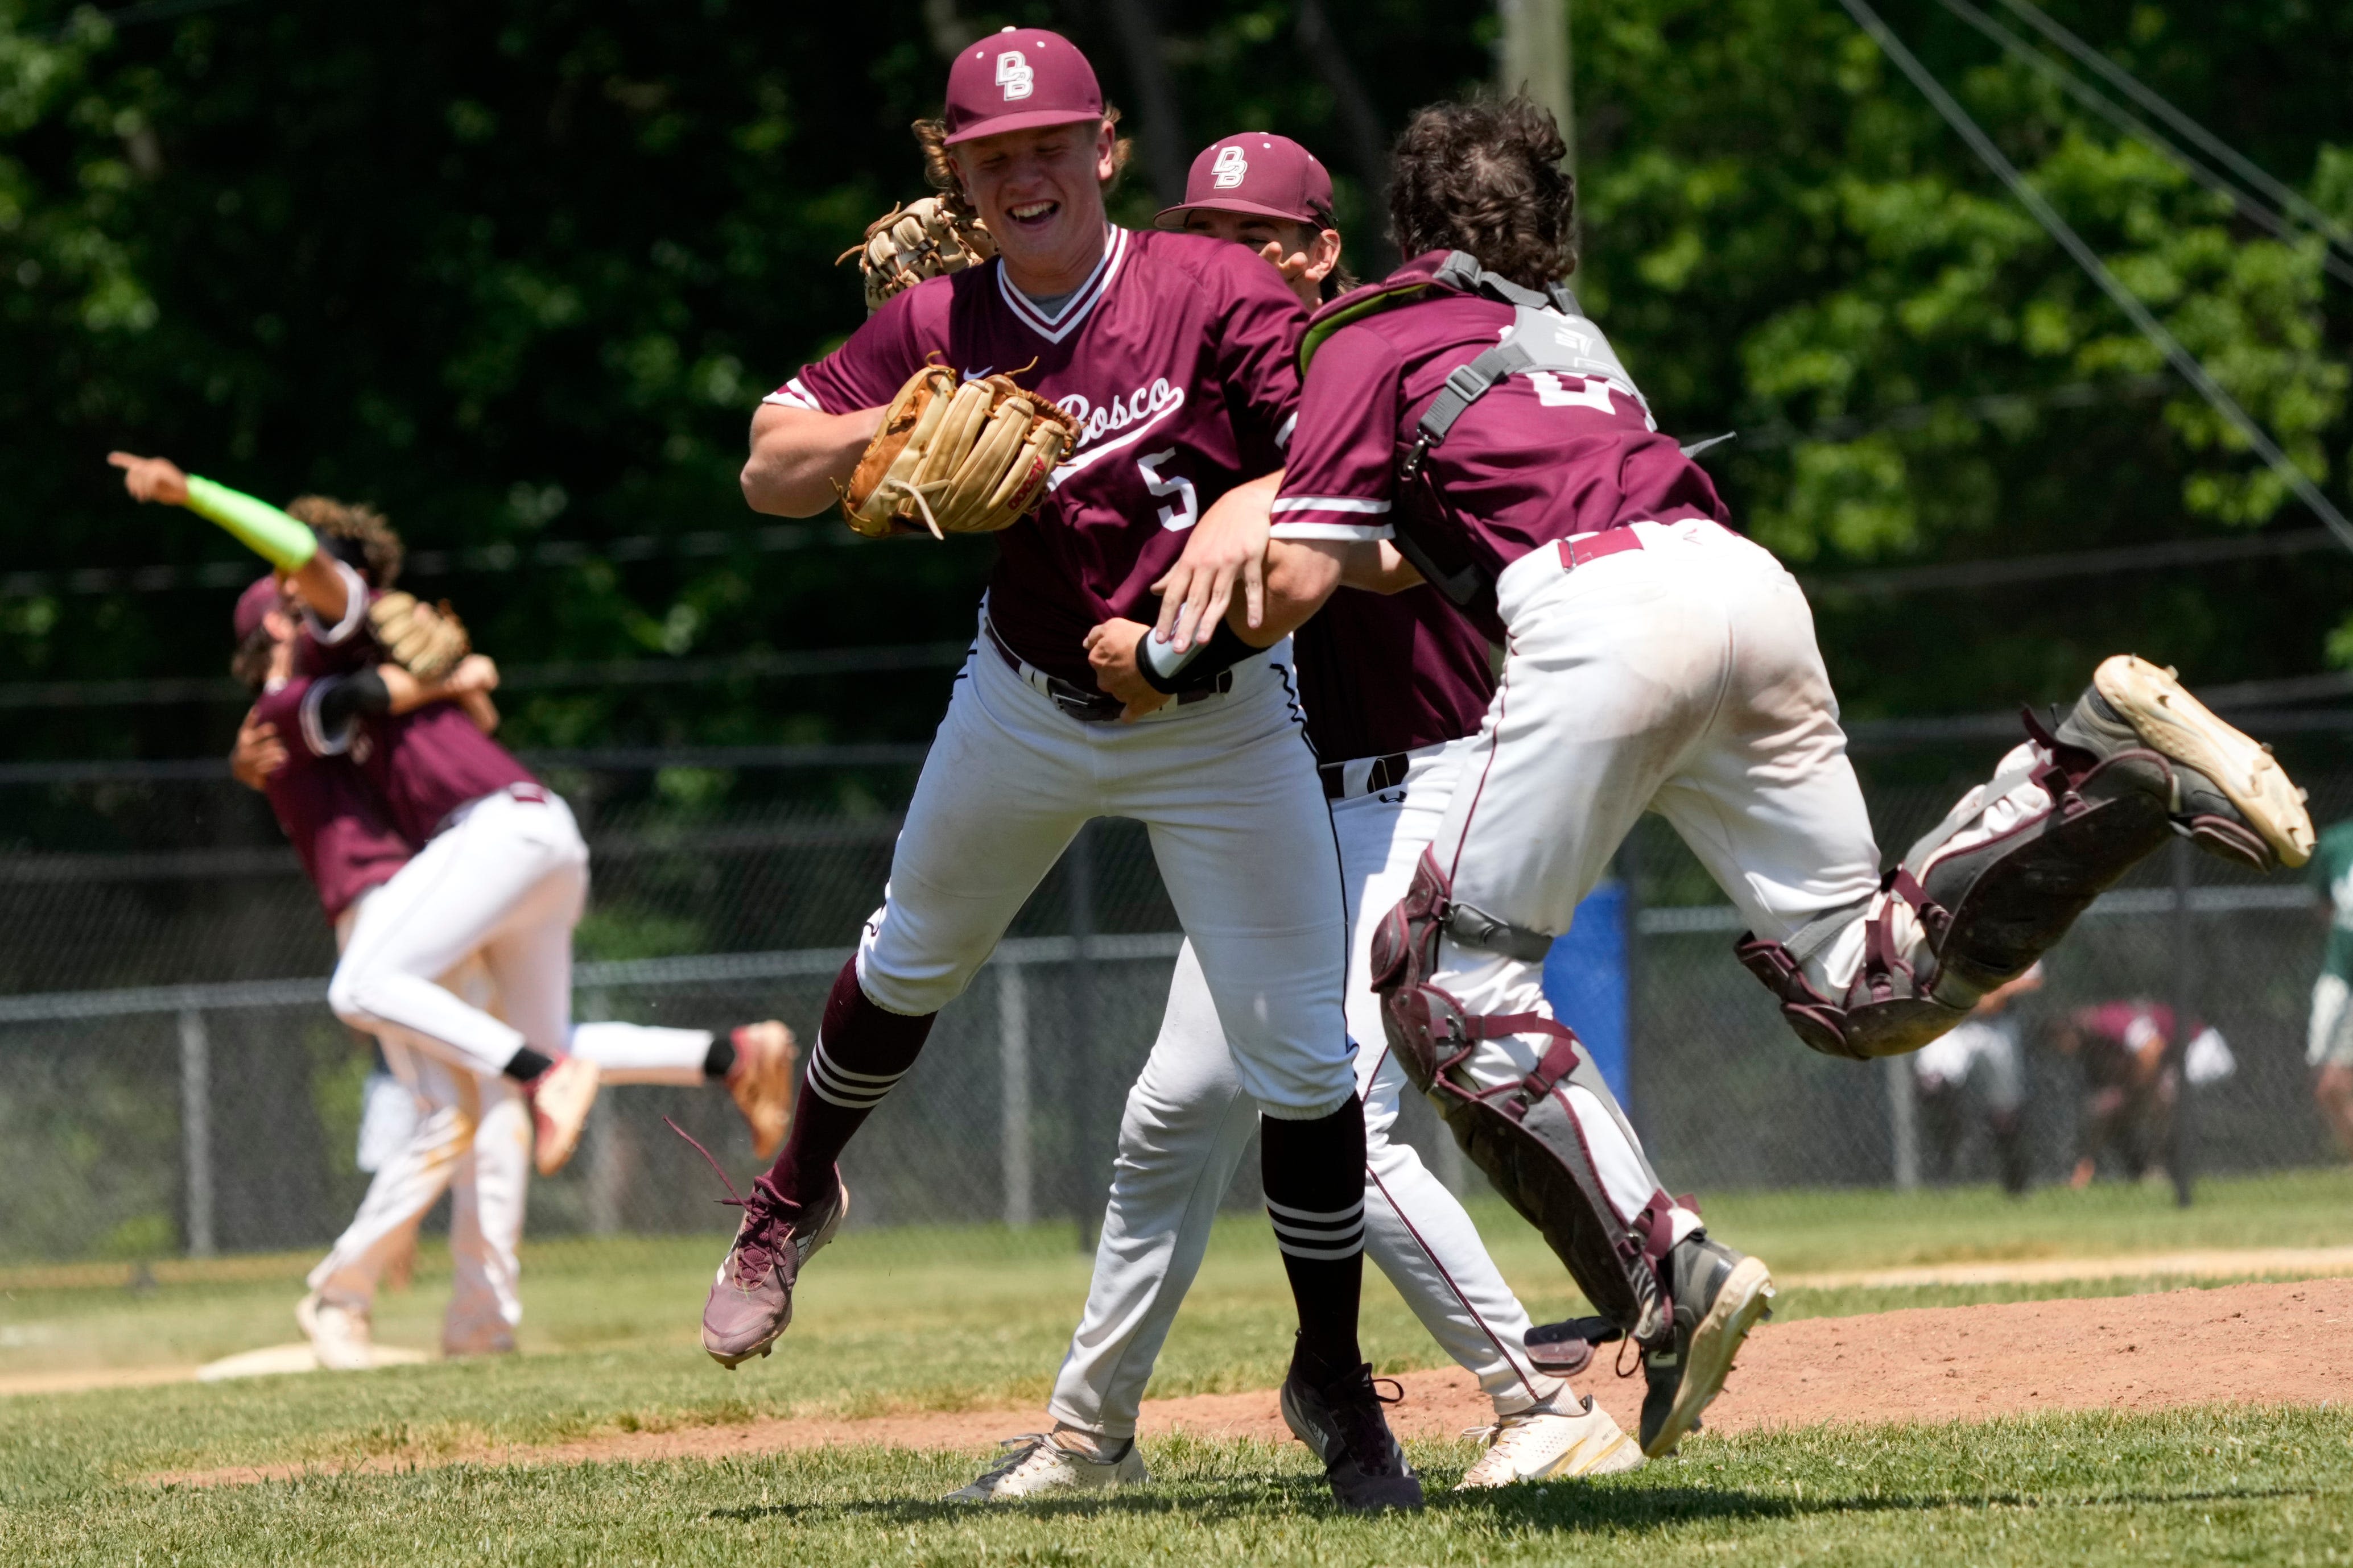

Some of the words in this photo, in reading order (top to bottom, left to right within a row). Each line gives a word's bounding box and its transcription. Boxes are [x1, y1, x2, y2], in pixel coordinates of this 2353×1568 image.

[996, 51, 1034, 101] DB
[1211, 146, 1248, 189] DB
[1056, 377, 1185, 448] Bosco
[1008, 454, 1046, 511] A2000
[1137, 446, 1198, 532] 5
